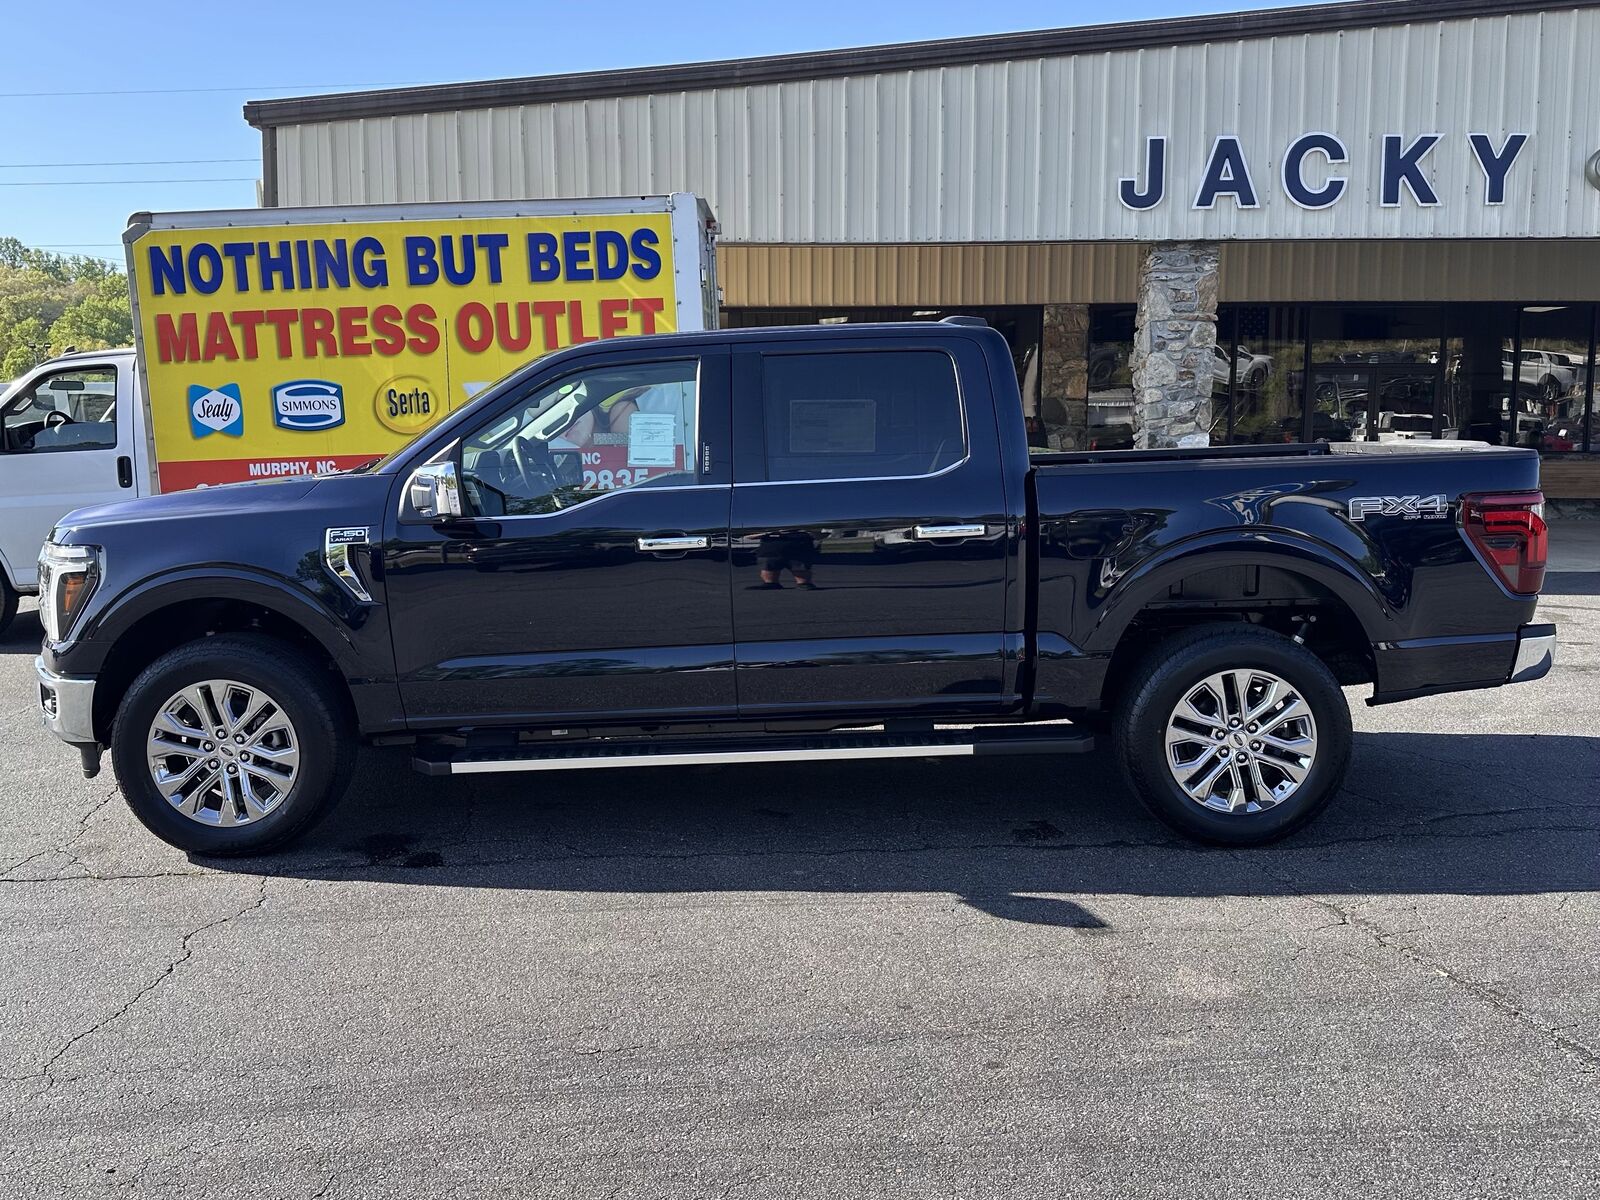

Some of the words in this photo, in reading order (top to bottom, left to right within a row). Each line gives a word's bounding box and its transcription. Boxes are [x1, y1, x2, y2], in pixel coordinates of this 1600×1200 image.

[1118, 131, 1530, 211] JACKY
[149, 236, 389, 296] NOTHING
[404, 232, 509, 287] BUT
[529, 228, 662, 283] BEDS
[157, 303, 441, 364] MATTRESS
[455, 297, 665, 353] OUTLET
[197, 398, 234, 422] Sealy
[281, 398, 337, 412] SIMMONS
[387, 387, 430, 417] Serta
[1349, 494, 1448, 521] FX4
